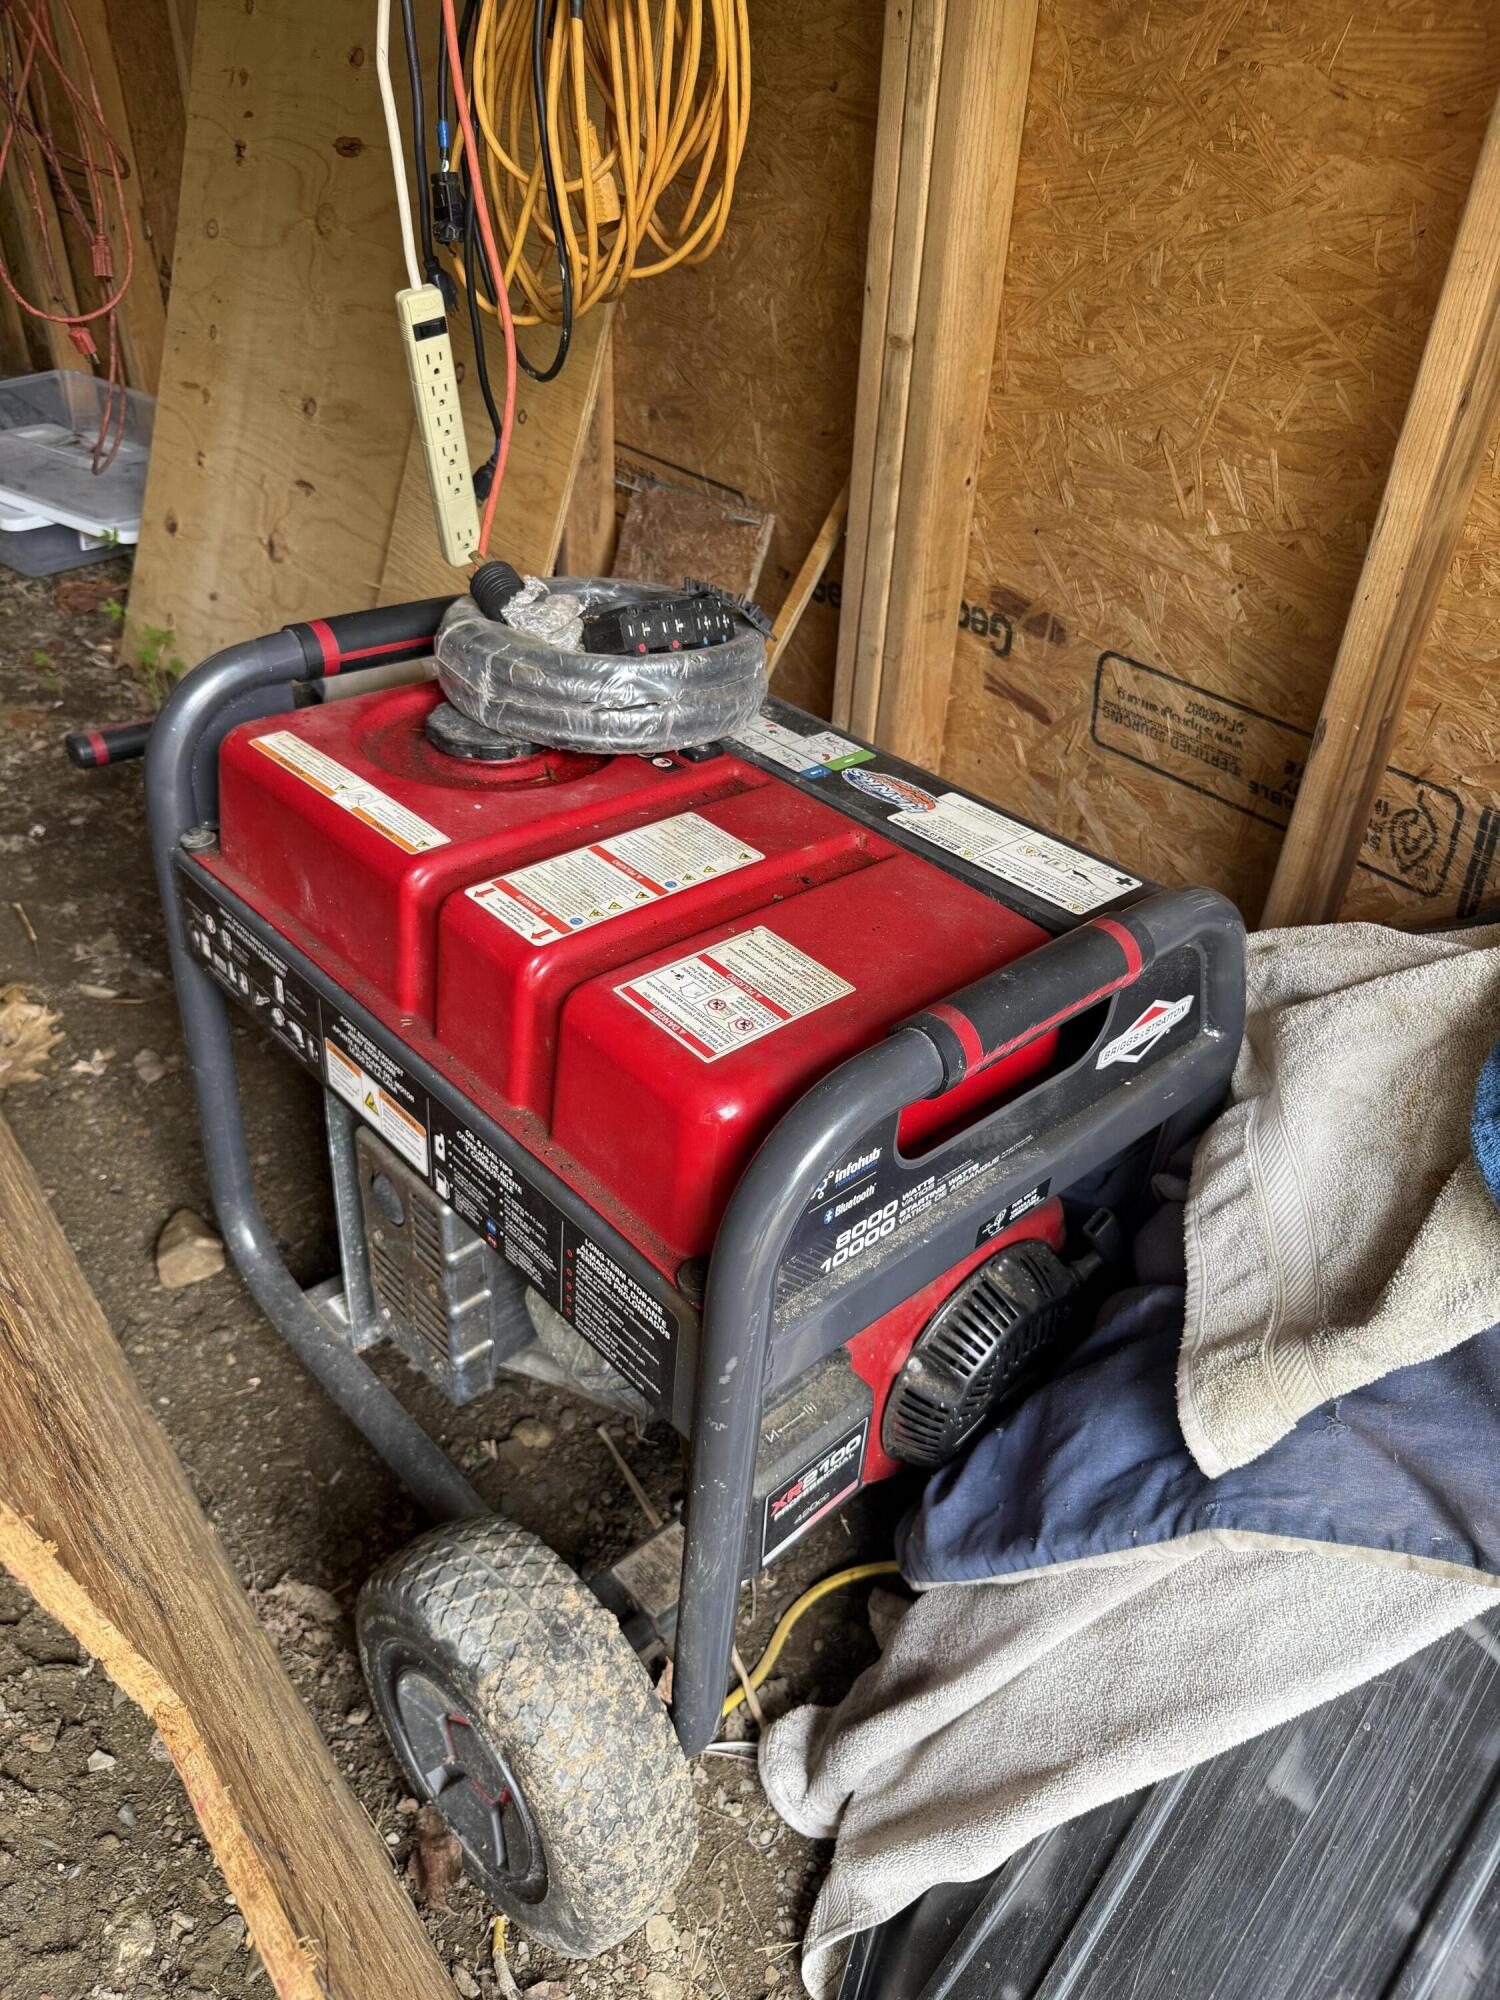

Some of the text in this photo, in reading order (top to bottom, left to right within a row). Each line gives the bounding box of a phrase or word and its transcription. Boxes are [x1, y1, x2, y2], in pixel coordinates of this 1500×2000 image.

[725, 973, 757, 994] PELIGRO
[648, 1007, 680, 1030] DANGER
[1104, 1032, 1139, 1061] BRIGGS
[1144, 1004, 1187, 1035] STRATTON
[456, 1127, 488, 1165] CONSEJOS
[490, 1159, 499, 1174] DE
[500, 1168, 522, 1196] ACEITE
[464, 1142, 469, 1153] Y
[470, 1147, 513, 1195] COMBUSTIBLE
[465, 1127, 475, 1143] OIL
[483, 1144, 497, 1164] FUEL
[498, 1157, 513, 1178] TIPS
[835, 1148, 881, 1183] infohub
[835, 1185, 876, 1217] Bluetooth
[899, 1183, 947, 1217] STARTING
[949, 1163, 980, 1186] WATTS
[899, 1199, 932, 1225] VATIOS
[934, 1190, 947, 1202] DE
[950, 1156, 1000, 1193] ARRANQUE
[901, 1185, 934, 1208] VATIOS
[902, 1176, 935, 1201] WATTS
[820, 1217, 895, 1273] 10000
[835, 1200, 898, 1250] 8000
[580, 1242, 628, 1294] ALMACENAJE
[630, 1288, 666, 1329] DURANTE
[585, 1237, 626, 1282] LONG-TERM
[627, 1276, 663, 1316] STORAGE
[613, 1280, 670, 1341] PROLONGADOS
[771, 1434, 862, 1517] XR2100
[774, 1453, 854, 1522] PROFESSIONAL
